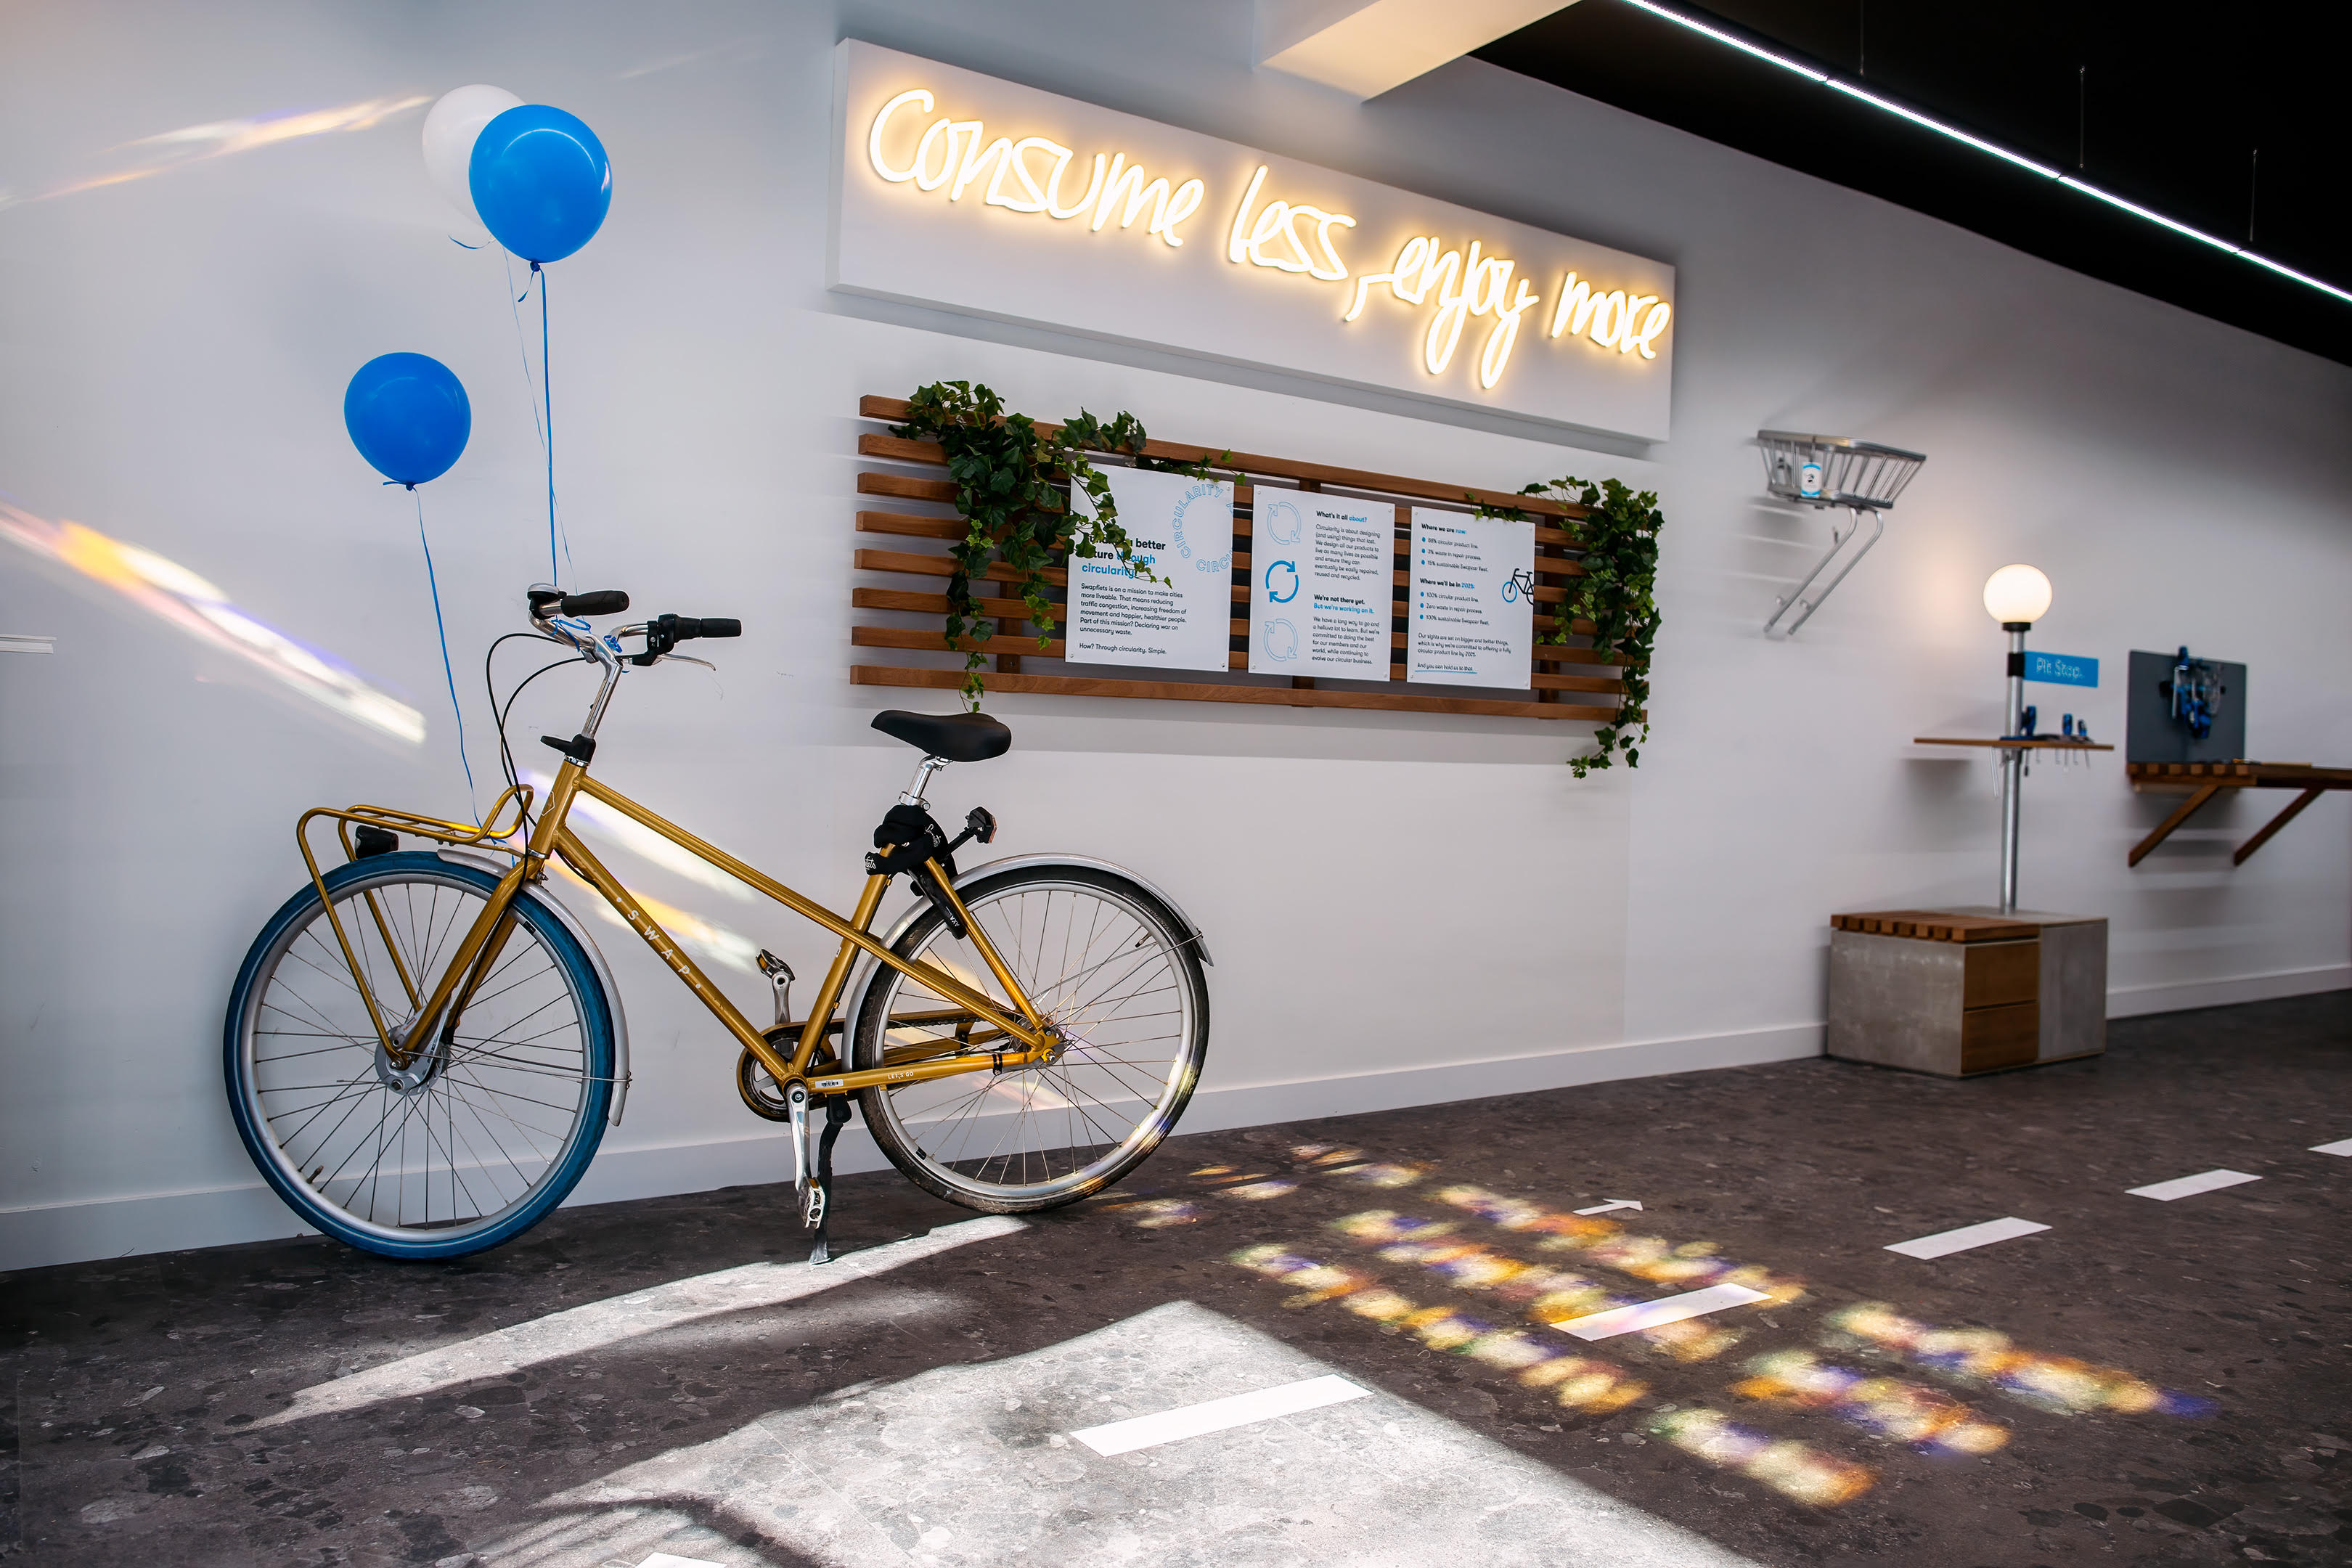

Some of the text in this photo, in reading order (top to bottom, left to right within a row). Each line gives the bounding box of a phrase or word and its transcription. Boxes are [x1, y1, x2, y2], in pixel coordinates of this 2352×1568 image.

[869, 88, 1204, 247] Consume
[1391, 235, 1540, 389] enjoy
[1551, 271, 1670, 359] more
[1172, 483, 1224, 559] CIRCULARITY
[1135, 538, 1166, 550] better
[1081, 582, 1108, 591] Swapfiets
[1131, 605, 1158, 613] increasing
[1135, 621, 1159, 630] Declaring
[1095, 643, 1118, 652] Through
[1119, 645, 1147, 654] circularity.
[2035, 657, 2051, 674] Pit
[627, 910, 690, 975] SWAP
